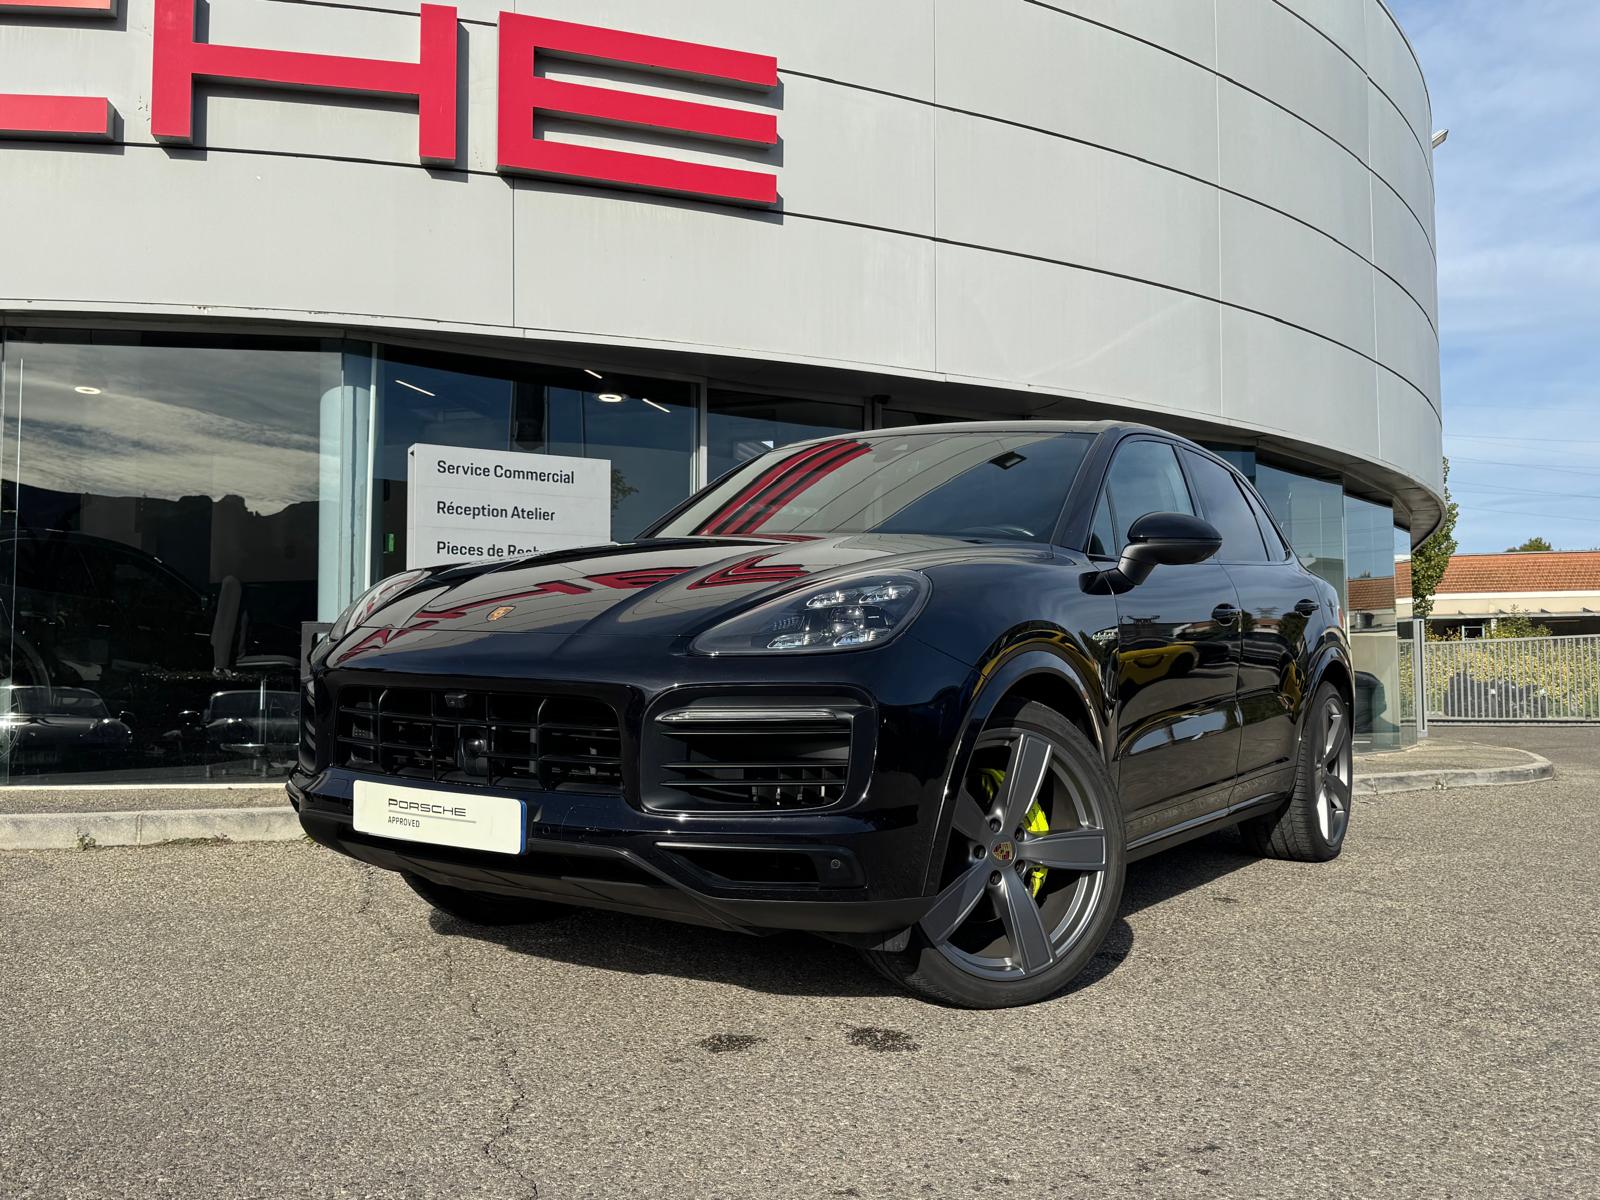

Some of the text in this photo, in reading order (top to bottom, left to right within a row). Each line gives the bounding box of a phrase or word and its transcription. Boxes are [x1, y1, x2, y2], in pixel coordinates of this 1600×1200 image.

[437, 460, 575, 484] Service Commercial
[437, 501, 556, 521] Réception Atelier
[437, 541, 484, 556] Pieces
[487, 544, 504, 557] de
[388, 798, 467, 817] PORSCHE
[388, 816, 421, 828] APPROVED
